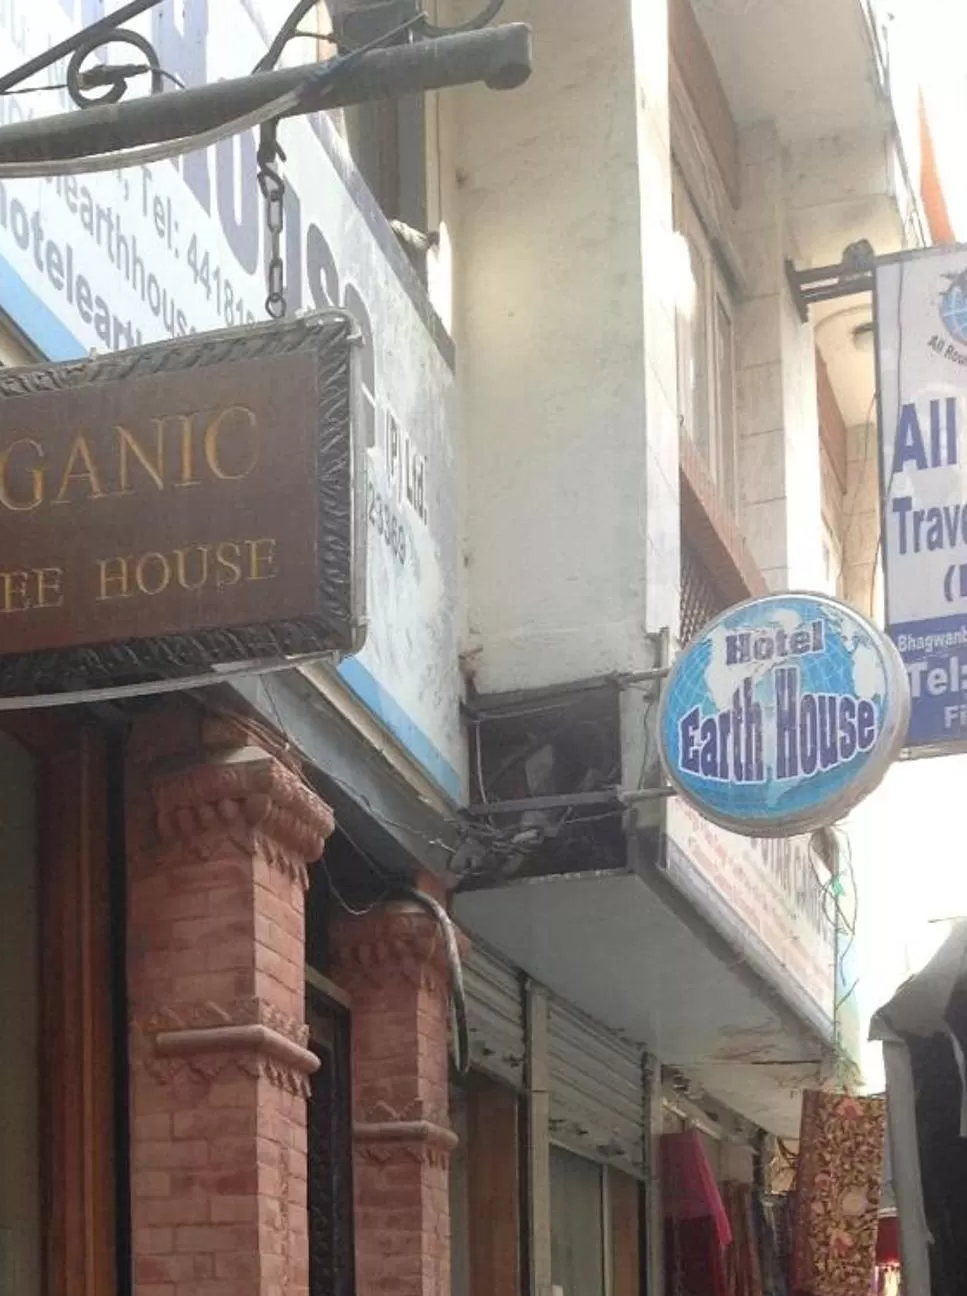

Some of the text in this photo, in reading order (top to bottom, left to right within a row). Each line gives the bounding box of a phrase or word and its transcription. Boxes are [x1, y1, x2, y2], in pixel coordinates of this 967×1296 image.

[141, 166, 180, 258] Tel:
[892, 398, 957, 473] All
[94, 538, 278, 601] HOUSE
[724, 619, 825, 667] Hotel
[679, 666, 876, 784] Earth House
